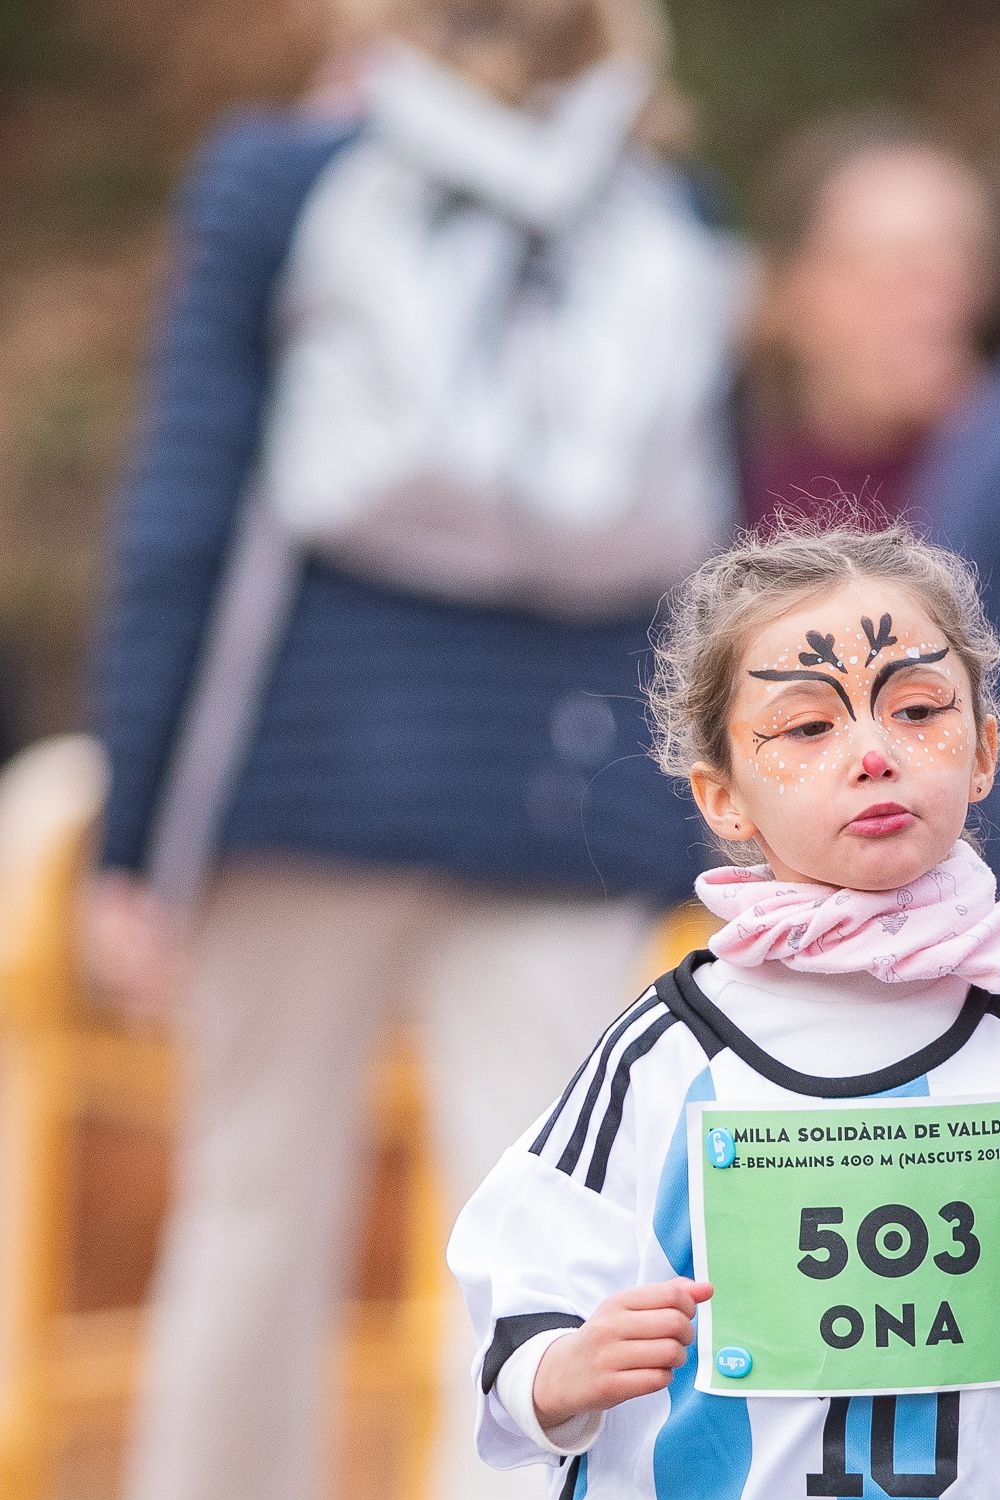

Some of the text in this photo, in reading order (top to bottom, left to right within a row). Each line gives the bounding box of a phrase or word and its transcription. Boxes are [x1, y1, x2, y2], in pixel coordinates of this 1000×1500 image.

[734, 1127, 790, 1143] MILLA
[798, 1122, 907, 1142] SOLIDÀRIA
[914, 1123, 940, 1139] DE
[713, 1155, 835, 1169] E-BENJAMINS
[841, 1154, 874, 1167] 400
[880, 1154, 893, 1166] M
[898, 1151, 973, 1169] (NASCUTS
[796, 1200, 981, 1280] 503
[819, 1301, 964, 1349] ONA
[806, 1390, 960, 1498] 10
